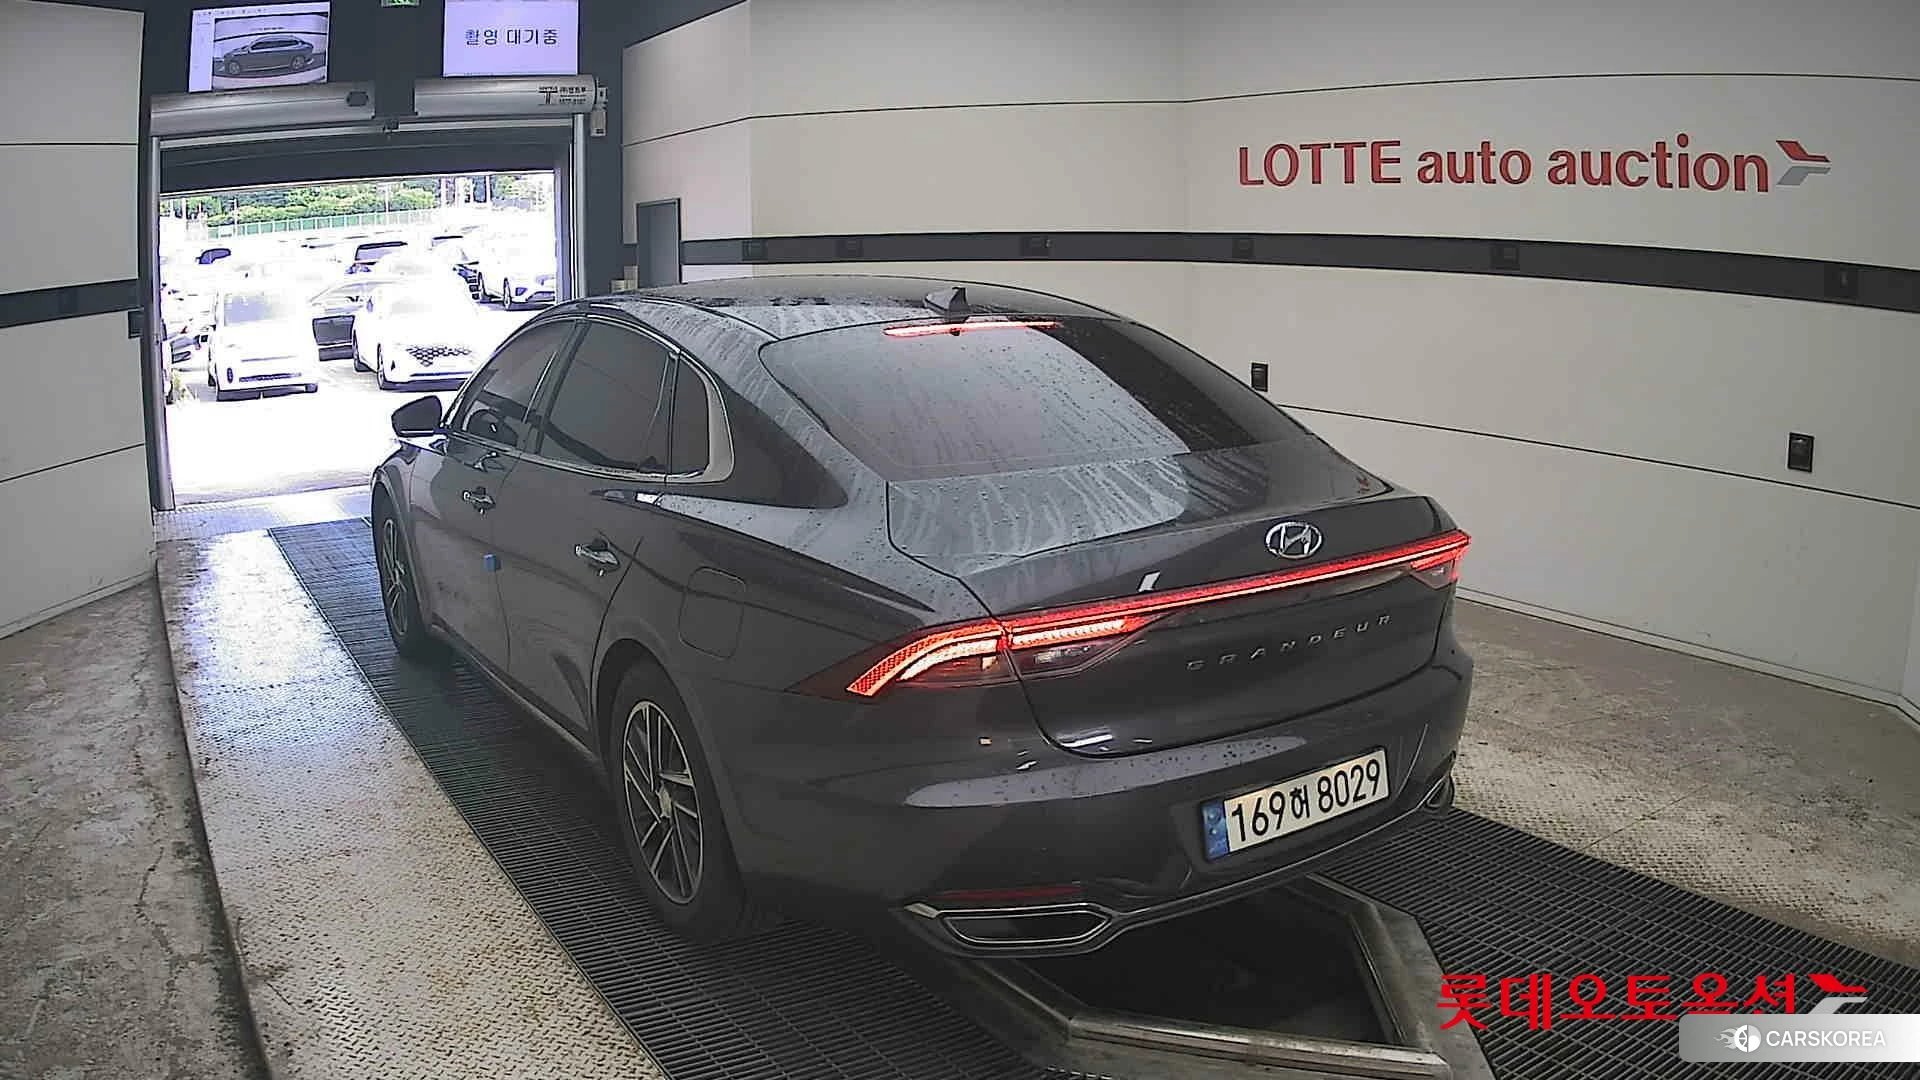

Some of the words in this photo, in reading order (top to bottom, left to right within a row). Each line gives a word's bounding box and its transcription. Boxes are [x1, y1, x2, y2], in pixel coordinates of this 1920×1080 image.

[465, 29, 498, 46] 촬영
[506, 29, 558, 46] 대기중
[1239, 140, 1401, 187] LOTTE
[1417, 141, 1532, 185] auto
[1548, 133, 1769, 193] auction
[1187, 614, 1392, 671] GRANDEUR
[1231, 785, 1311, 842] 169허
[1317, 759, 1381, 814] 8029
